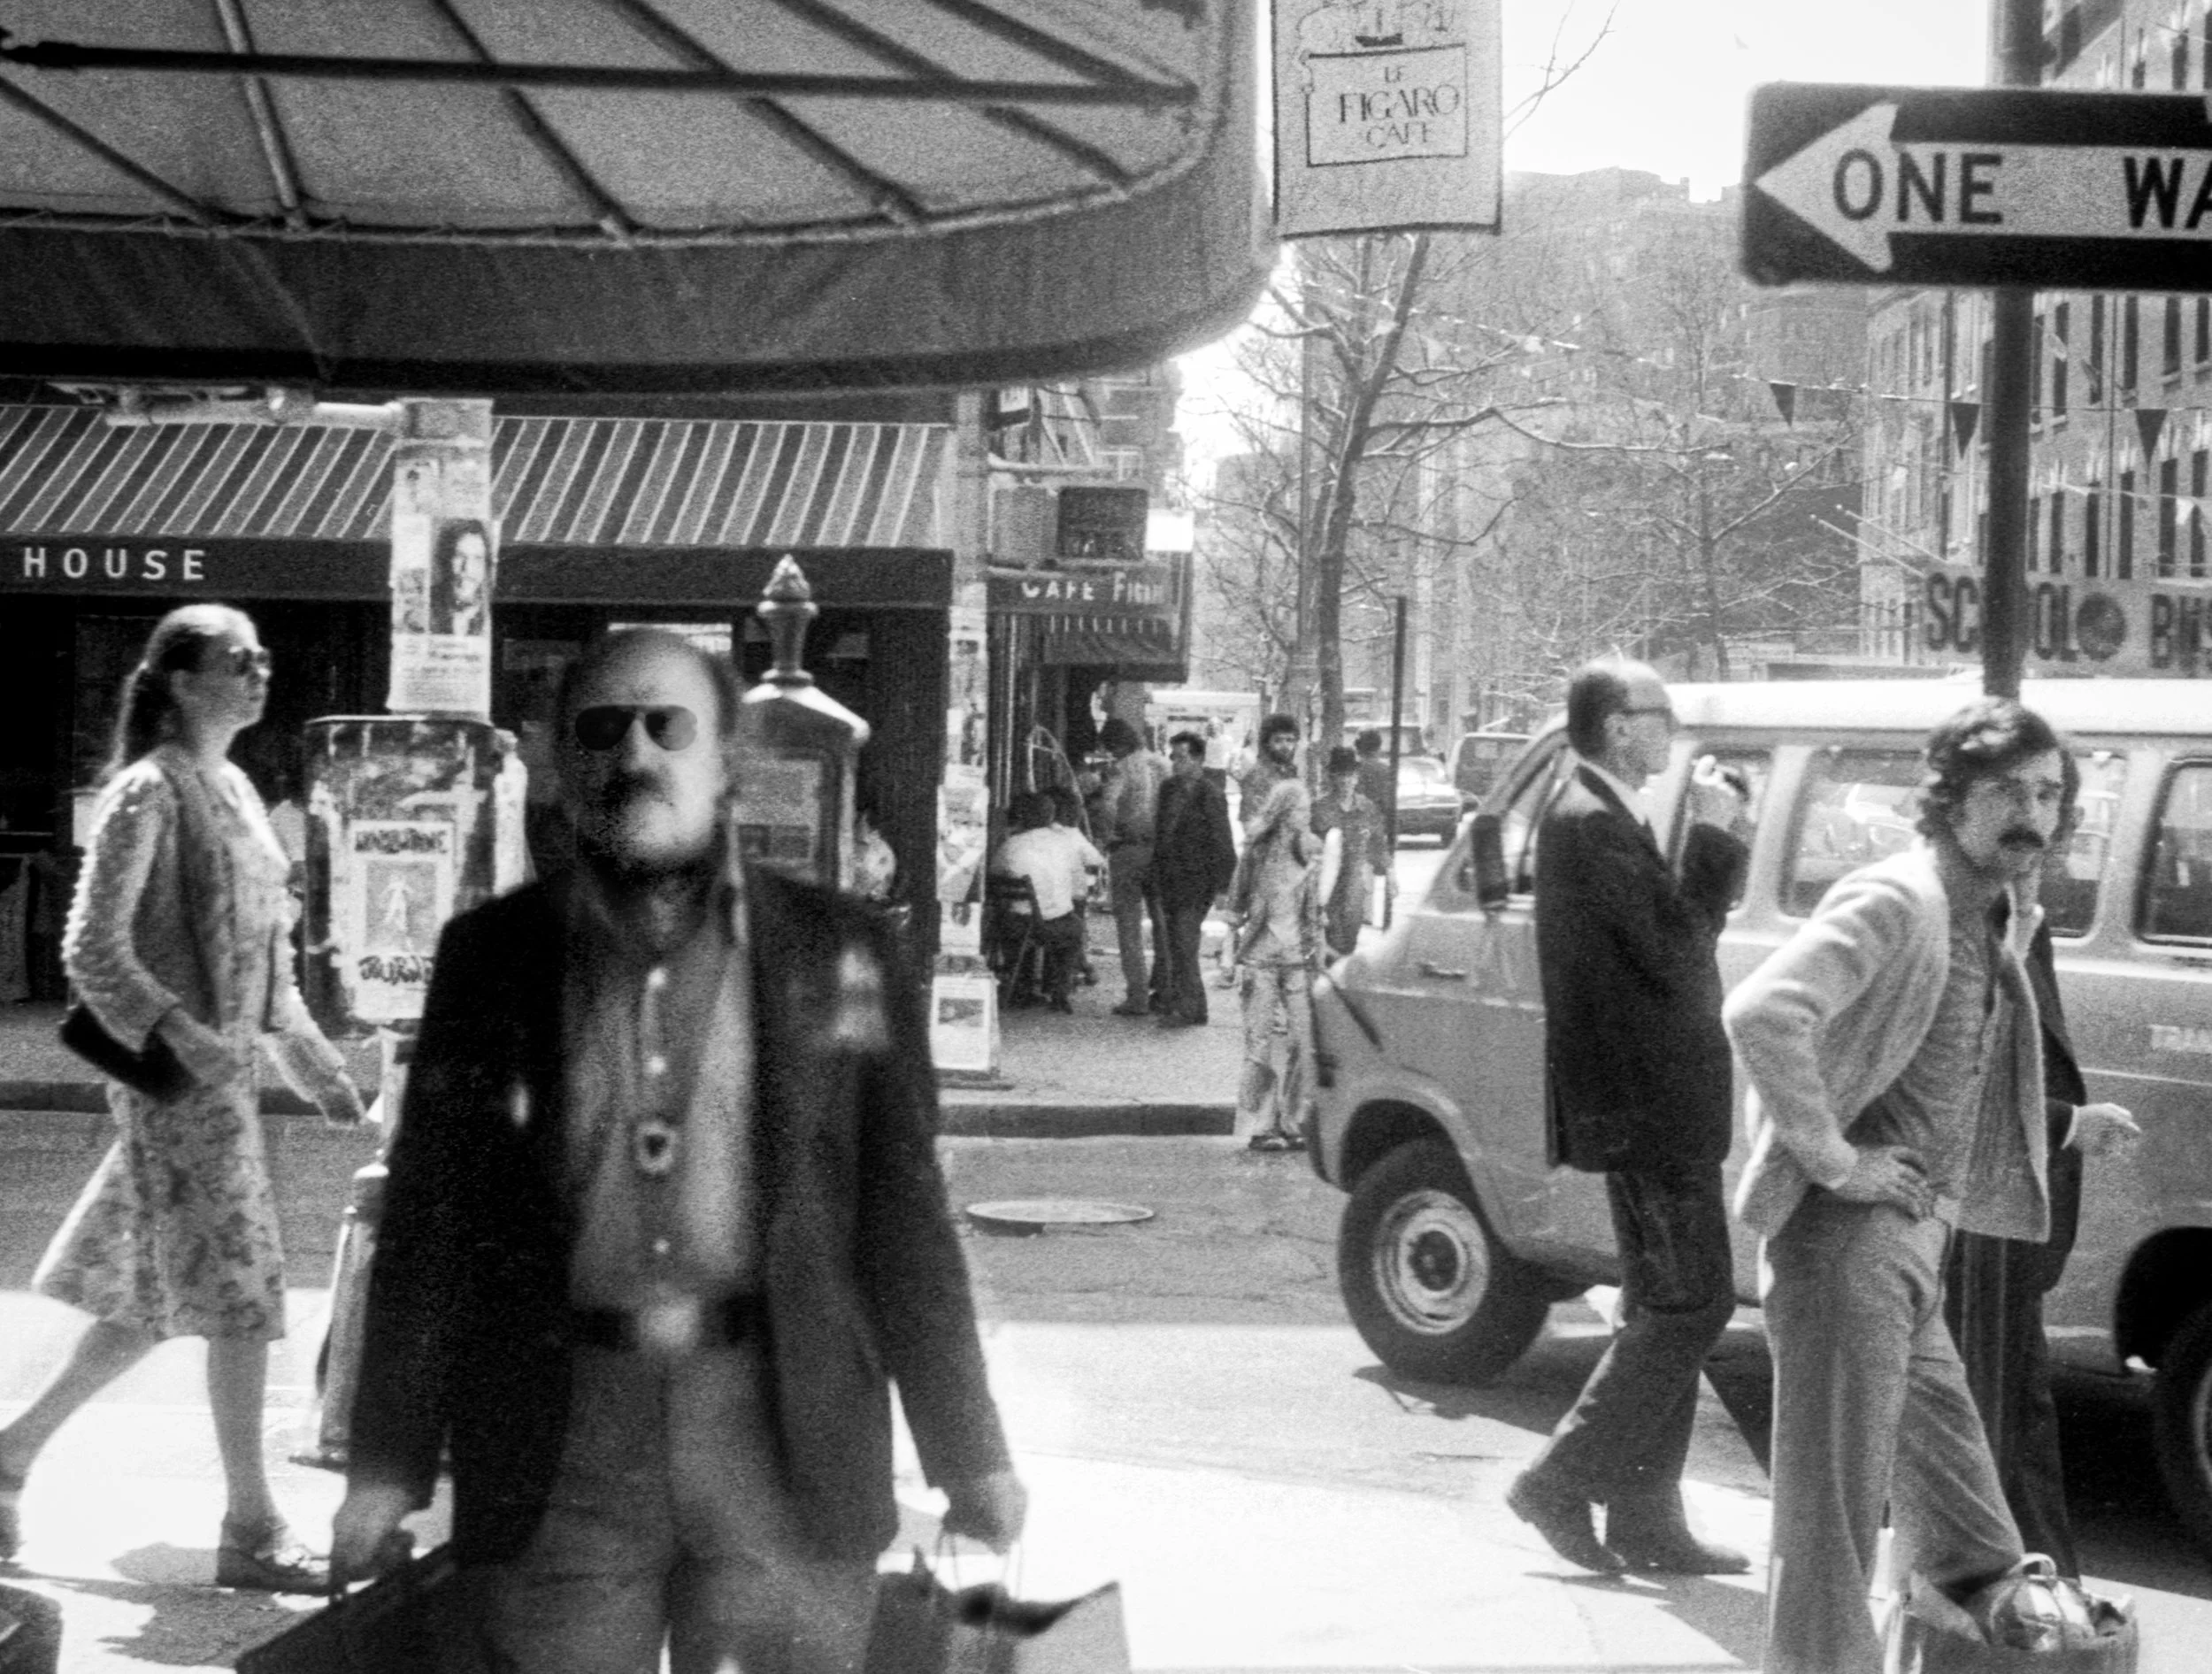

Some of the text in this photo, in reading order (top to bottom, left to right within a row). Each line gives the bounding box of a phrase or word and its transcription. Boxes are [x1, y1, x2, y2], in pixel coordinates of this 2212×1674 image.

[1339, 83, 1460, 124] FIGARO
[1833, 148, 2003, 225] ONE
[24, 546, 206, 581] HOUSE
